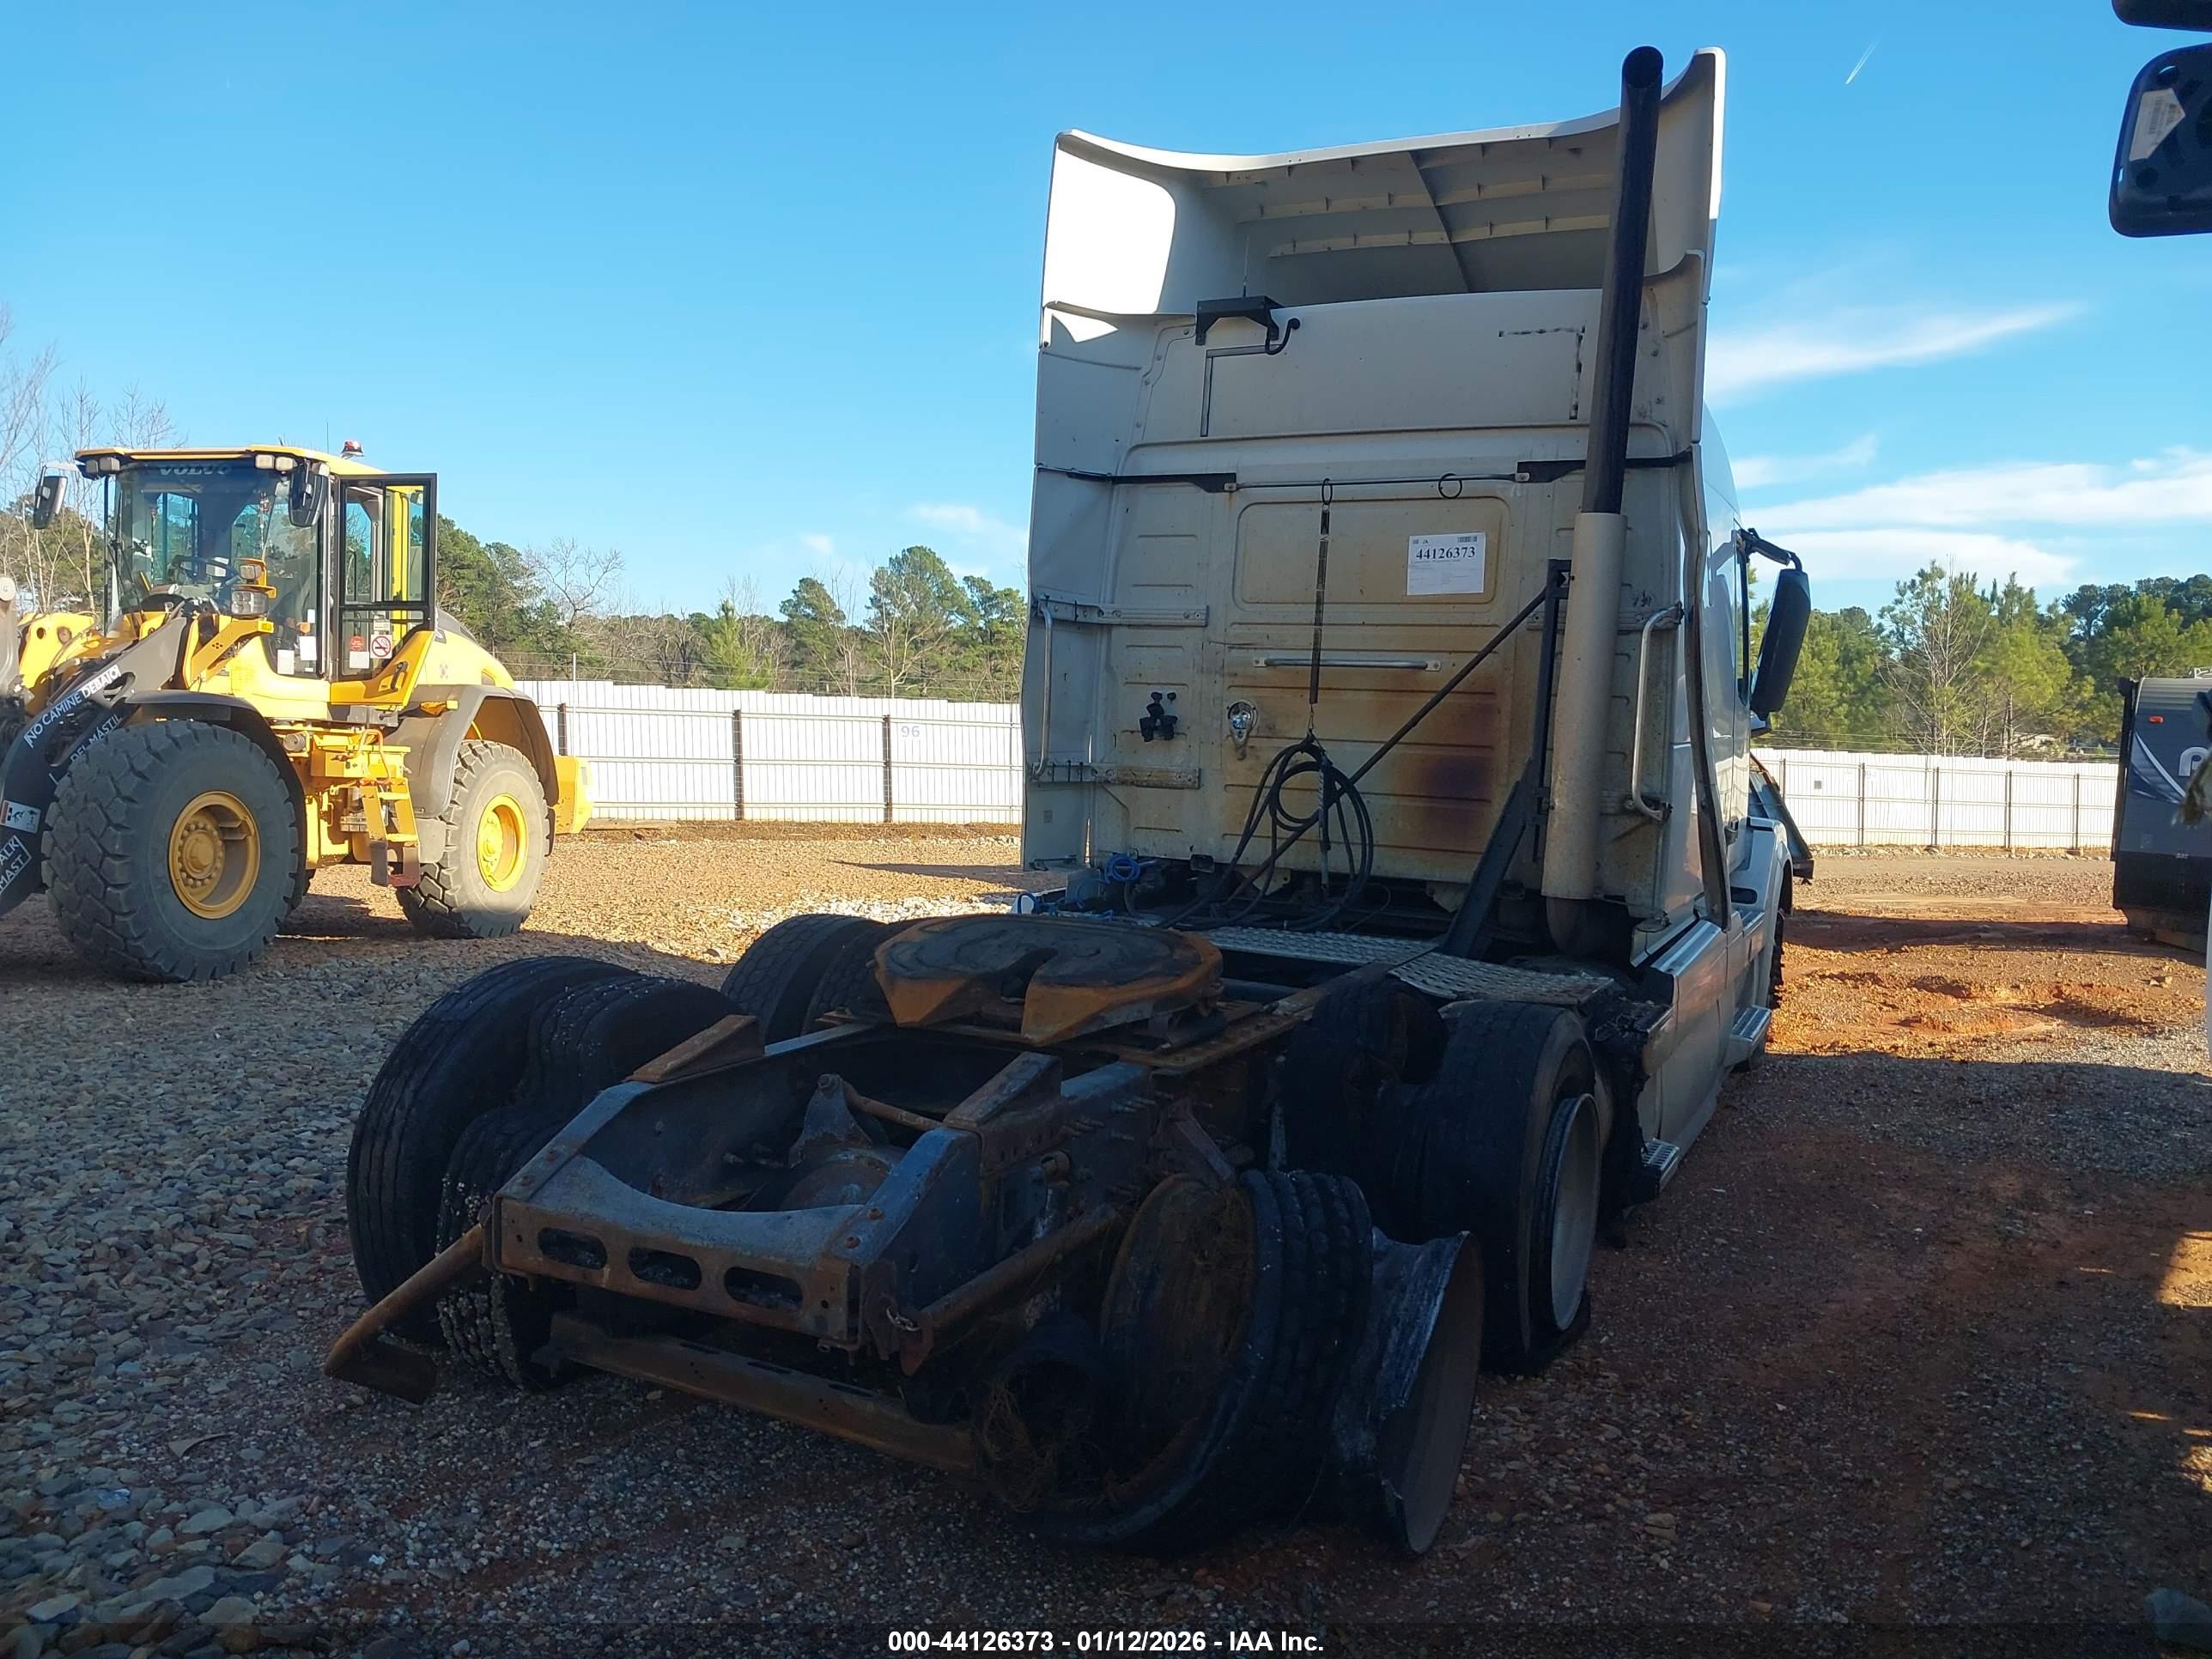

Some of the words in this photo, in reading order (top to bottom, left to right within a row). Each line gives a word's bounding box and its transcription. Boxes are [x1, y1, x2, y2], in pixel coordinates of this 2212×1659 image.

[1415, 546, 1476, 560] 44126373
[26, 722, 44, 744] NO
[42, 691, 82, 726] CAMINE
[901, 726, 921, 738] 96
[0, 837, 19, 866] ALK
